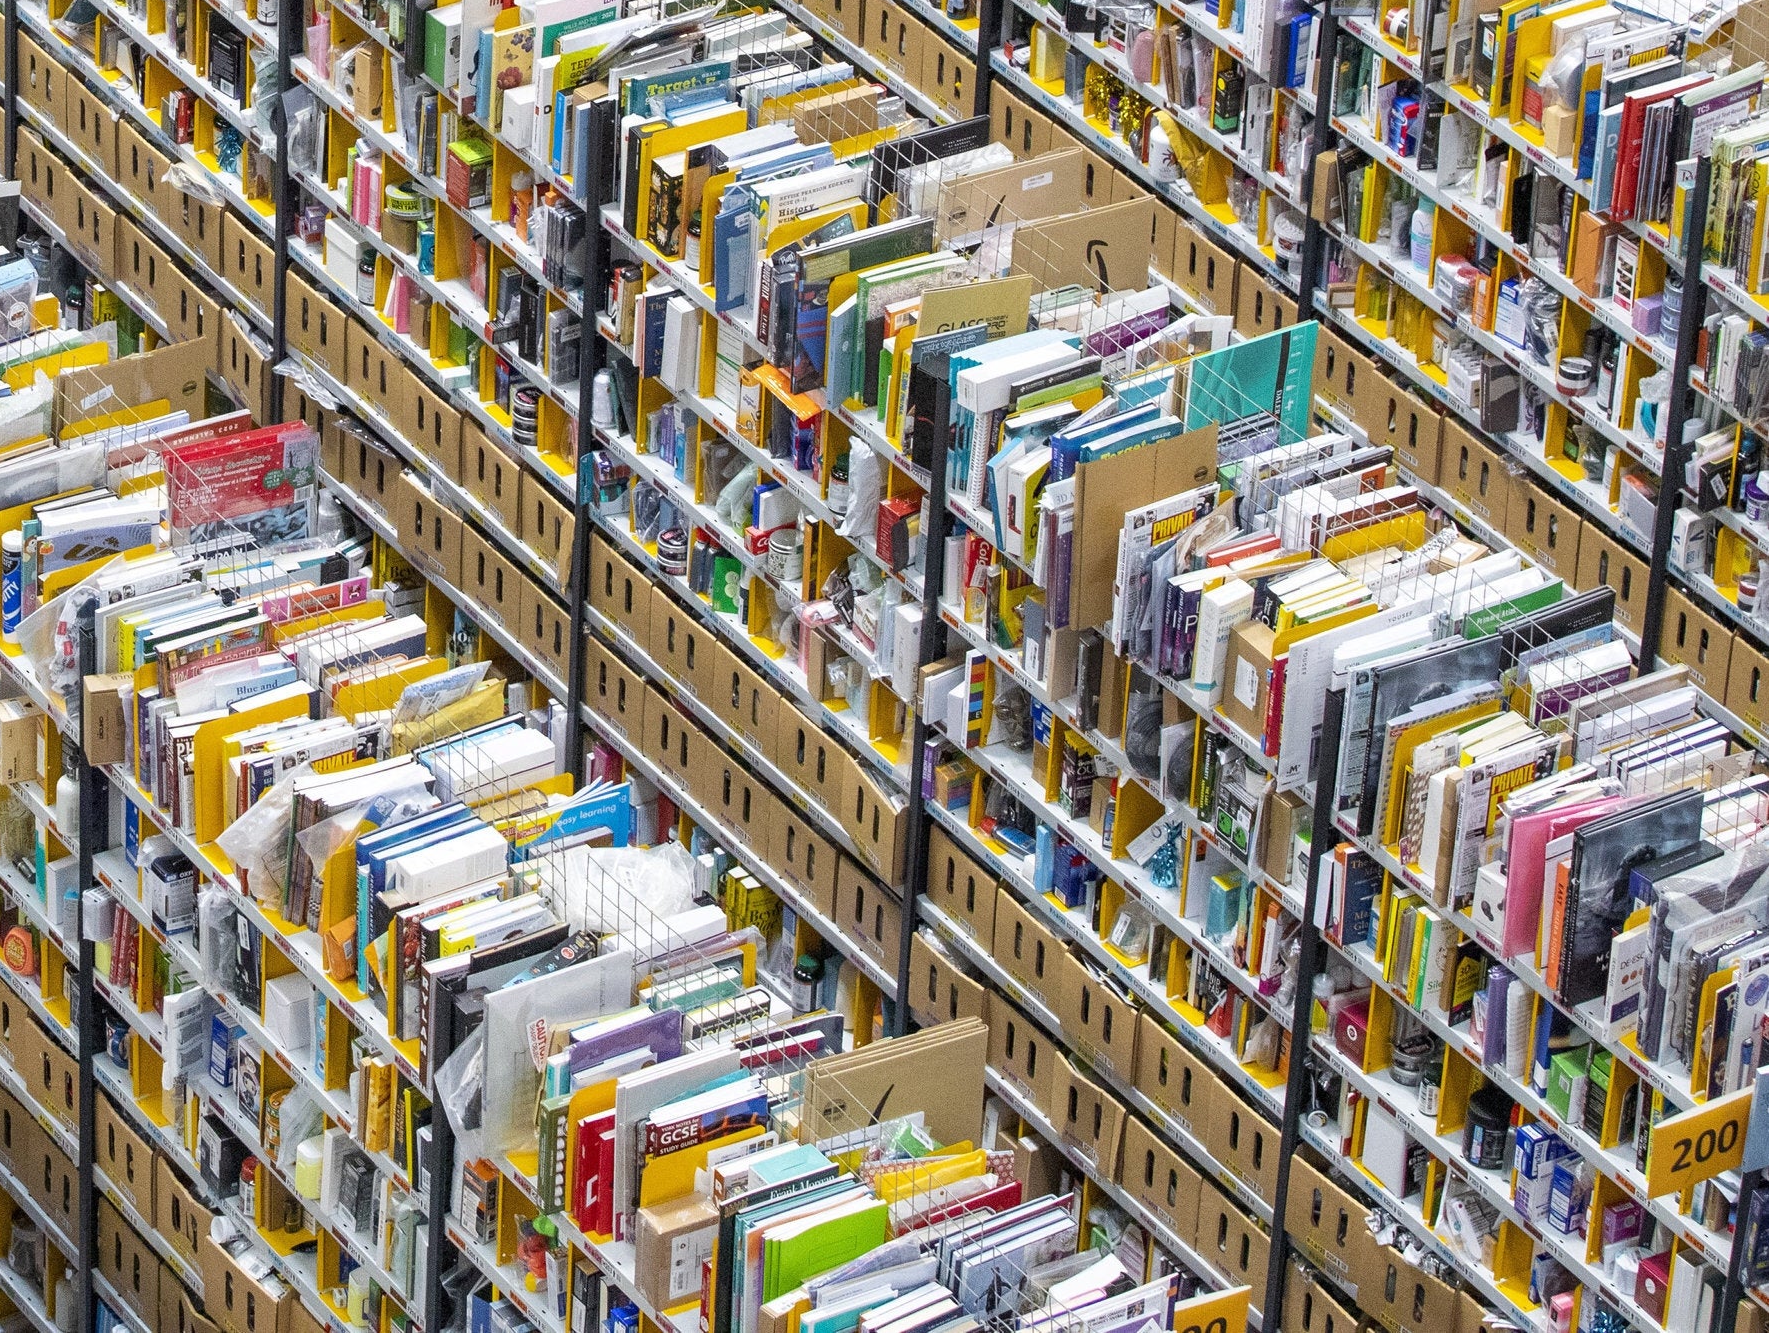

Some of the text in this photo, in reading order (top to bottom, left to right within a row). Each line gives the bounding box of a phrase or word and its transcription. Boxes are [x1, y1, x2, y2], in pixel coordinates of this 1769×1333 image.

[778, 203, 815, 218] History
[173, 429, 213, 444] CALENDAR
[1152, 509, 1195, 541] PRIVATE
[236, 680, 278, 696] Blue and
[1491, 765, 1535, 795] PRIVATE
[557, 803, 617, 829] easy learning
[661, 1123, 674, 1132] YORK
[676, 1119, 690, 1129] NOTES
[659, 1125, 699, 1145] GCSE
[660, 1138, 699, 1155] STUDY GUIDE
[1671, 1119, 1739, 1173] 200
